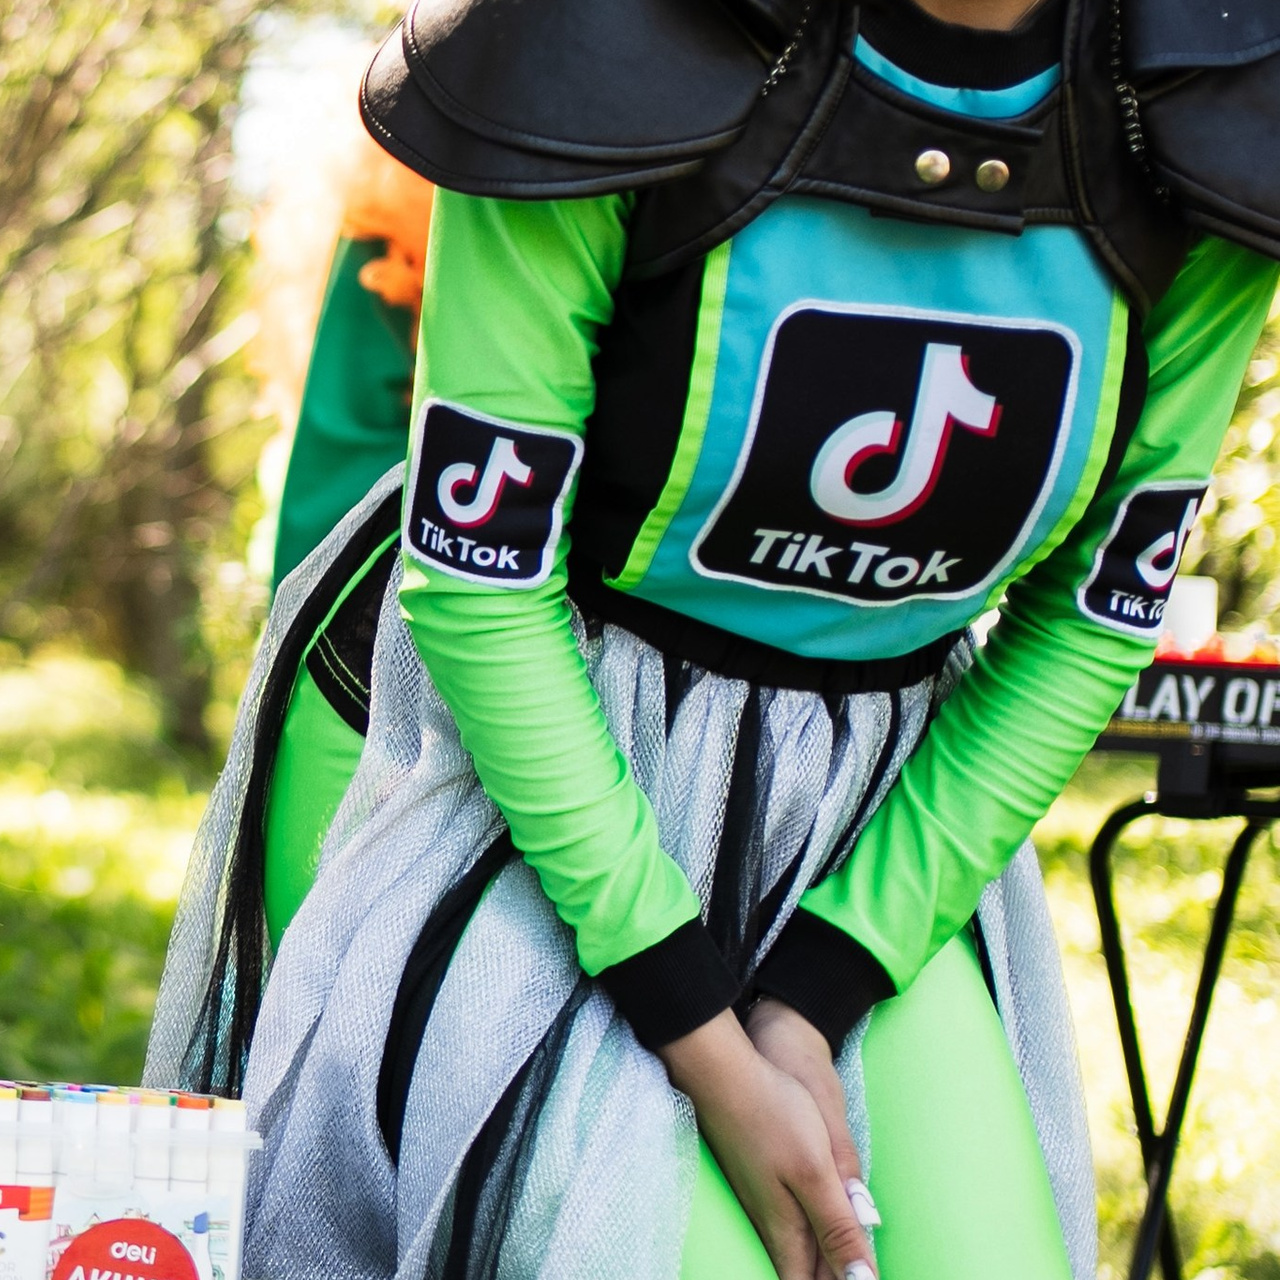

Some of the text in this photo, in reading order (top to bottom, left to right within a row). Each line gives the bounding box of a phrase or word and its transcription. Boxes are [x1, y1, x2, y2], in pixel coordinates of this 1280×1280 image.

[421, 517, 520, 570] TikTok
[749, 528, 963, 588] TikTok
[1110, 589, 1167, 620] TikTo
[1122, 673, 1216, 723] LAY
[110, 1241, 157, 1265] deli
